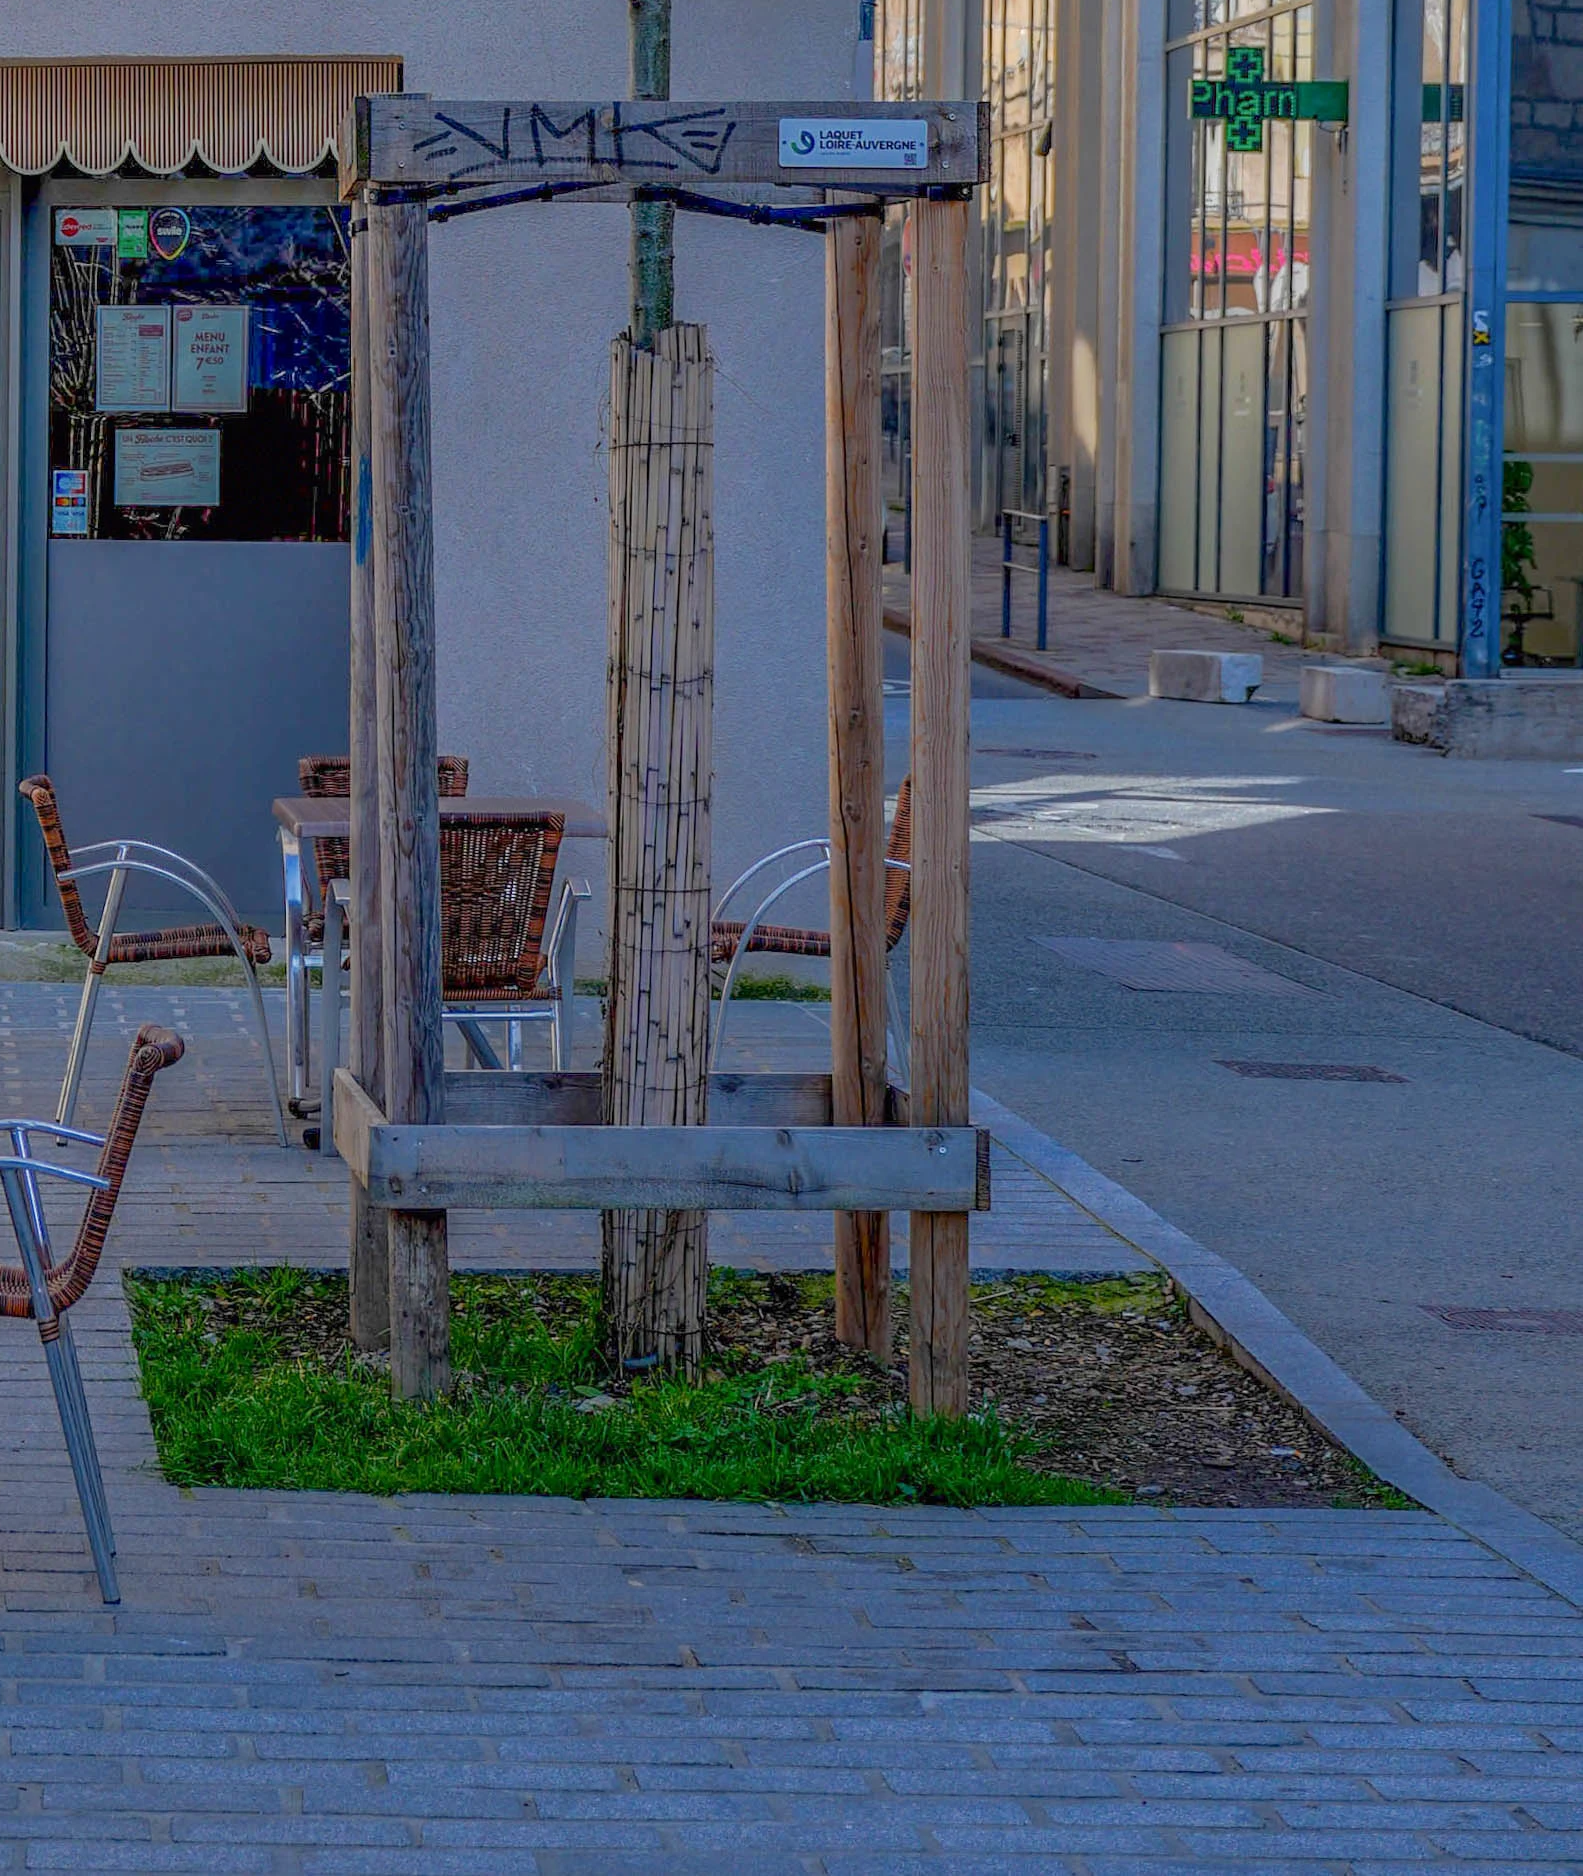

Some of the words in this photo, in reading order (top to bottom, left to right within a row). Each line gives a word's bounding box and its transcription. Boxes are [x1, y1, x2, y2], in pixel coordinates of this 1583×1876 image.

[819, 130, 864, 140] LAQUET
[819, 140, 917, 150] LOIRE-AUVERGNE
[194, 331, 226, 342] MENU
[190, 343, 230, 354] ENFANT
